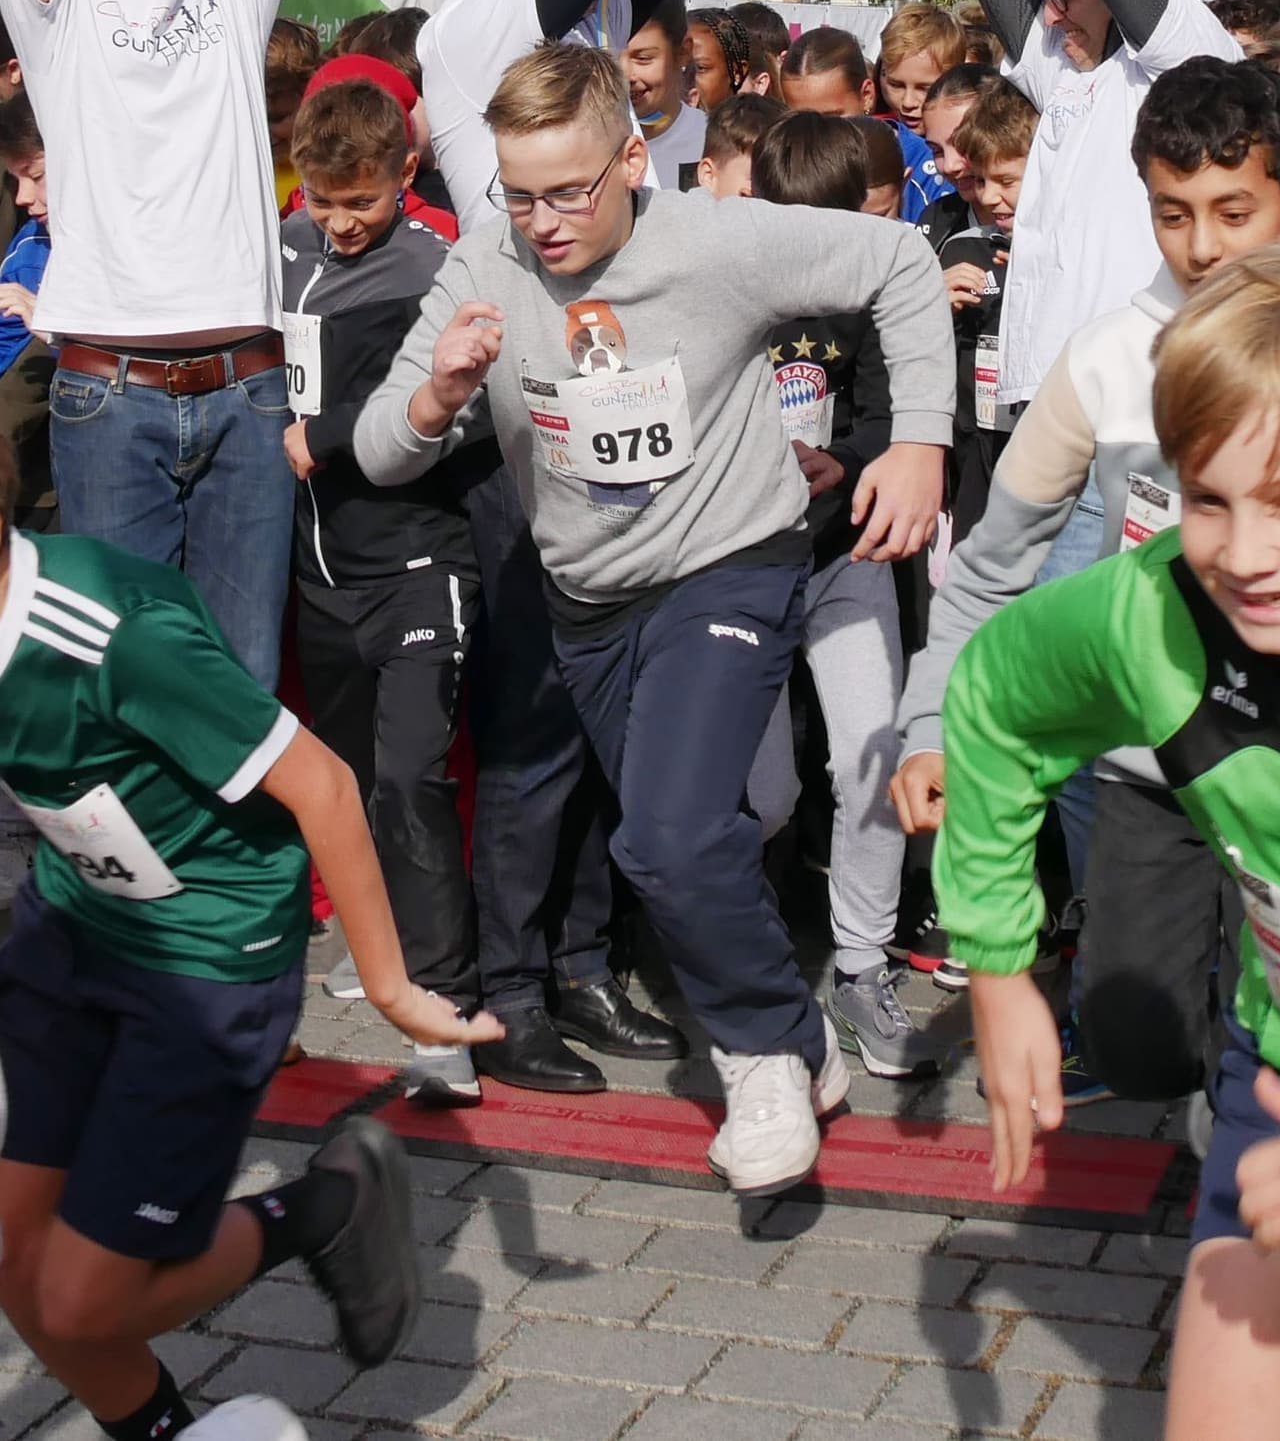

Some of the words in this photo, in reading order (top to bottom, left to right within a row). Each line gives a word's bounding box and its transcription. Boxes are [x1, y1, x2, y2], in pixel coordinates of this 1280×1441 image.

[592, 391, 643, 408] GUNZEN
[539, 430, 569, 445] REMA
[592, 422, 673, 465] 978
[402, 629, 436, 646] JAKO
[1211, 686, 1259, 719] erima
